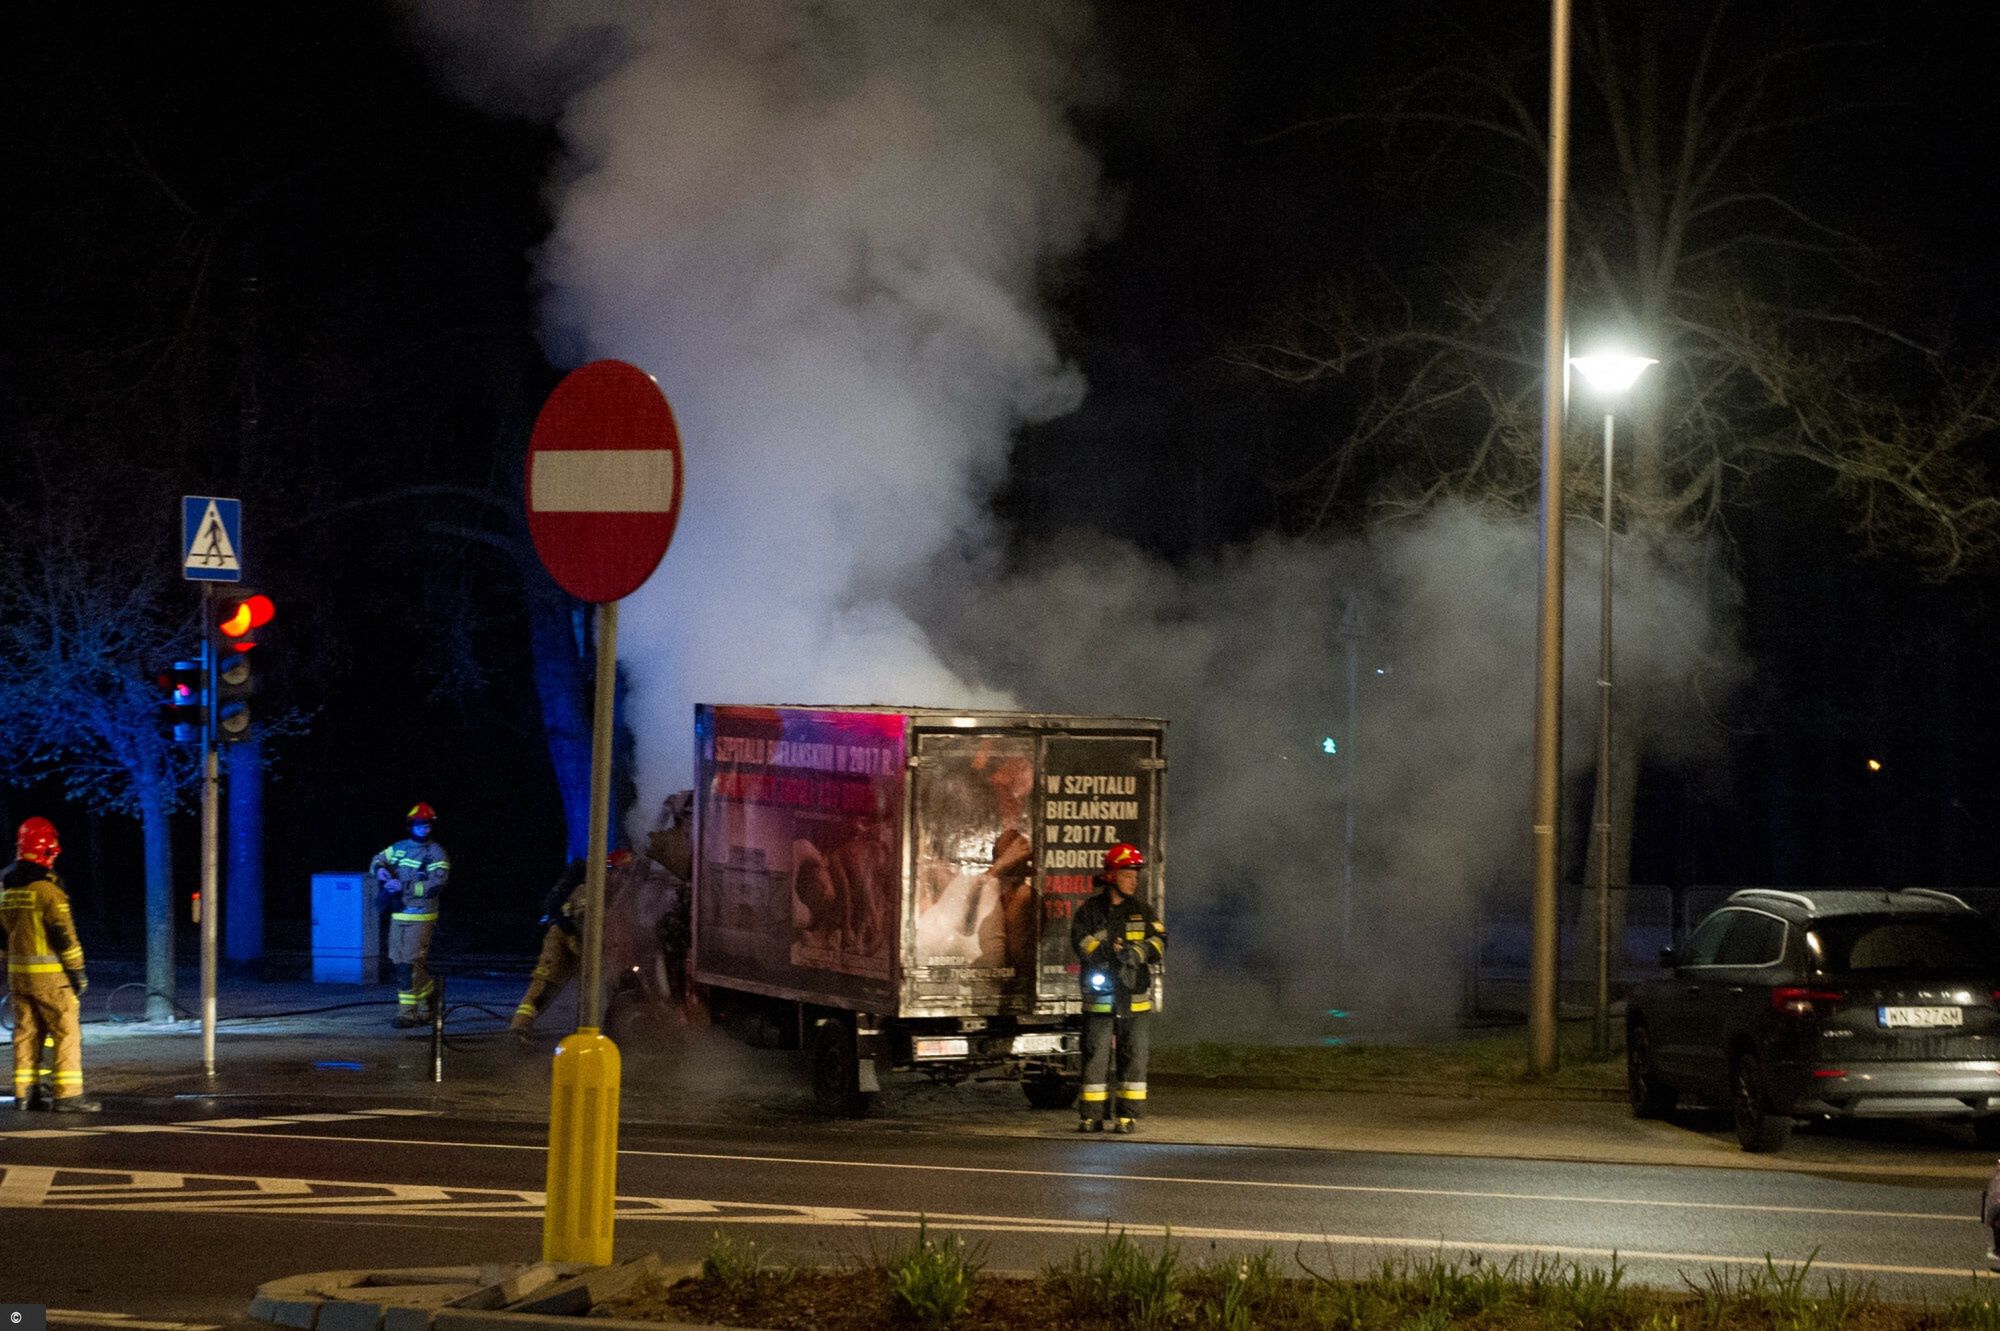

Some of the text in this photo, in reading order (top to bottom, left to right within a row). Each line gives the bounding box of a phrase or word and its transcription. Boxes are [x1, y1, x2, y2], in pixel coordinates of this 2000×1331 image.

[1047, 776, 1136, 795] W SZPITALU
[1046, 796, 1138, 819] BIELAŃSKIM
[1046, 825, 1120, 843] W 2017 R.
[1045, 850, 1108, 868] ABORTE
